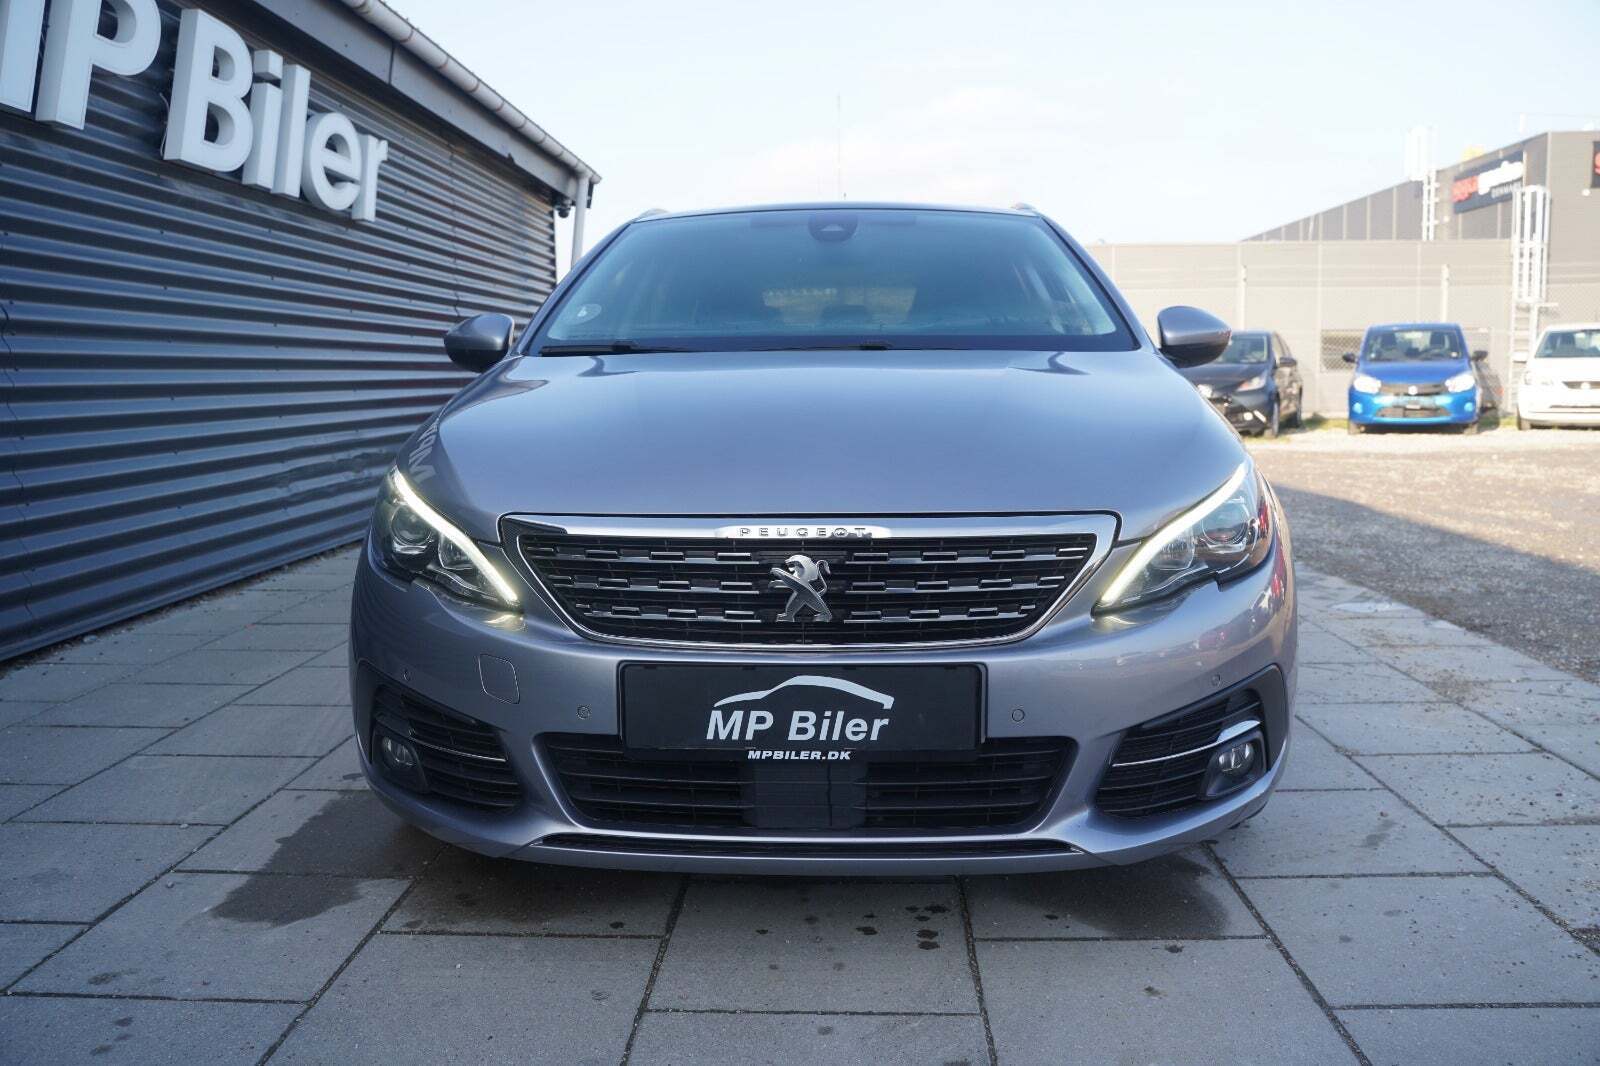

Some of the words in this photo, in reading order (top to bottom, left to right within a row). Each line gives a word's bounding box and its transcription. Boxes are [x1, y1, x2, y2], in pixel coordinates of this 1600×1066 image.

[0, 0, 161, 130] P
[163, 9, 388, 222] Biler
[739, 527, 867, 537] PEUGEOT
[706, 710, 774, 741] MP
[787, 710, 890, 741] Biler
[747, 750, 851, 760] MPBILER.DK
